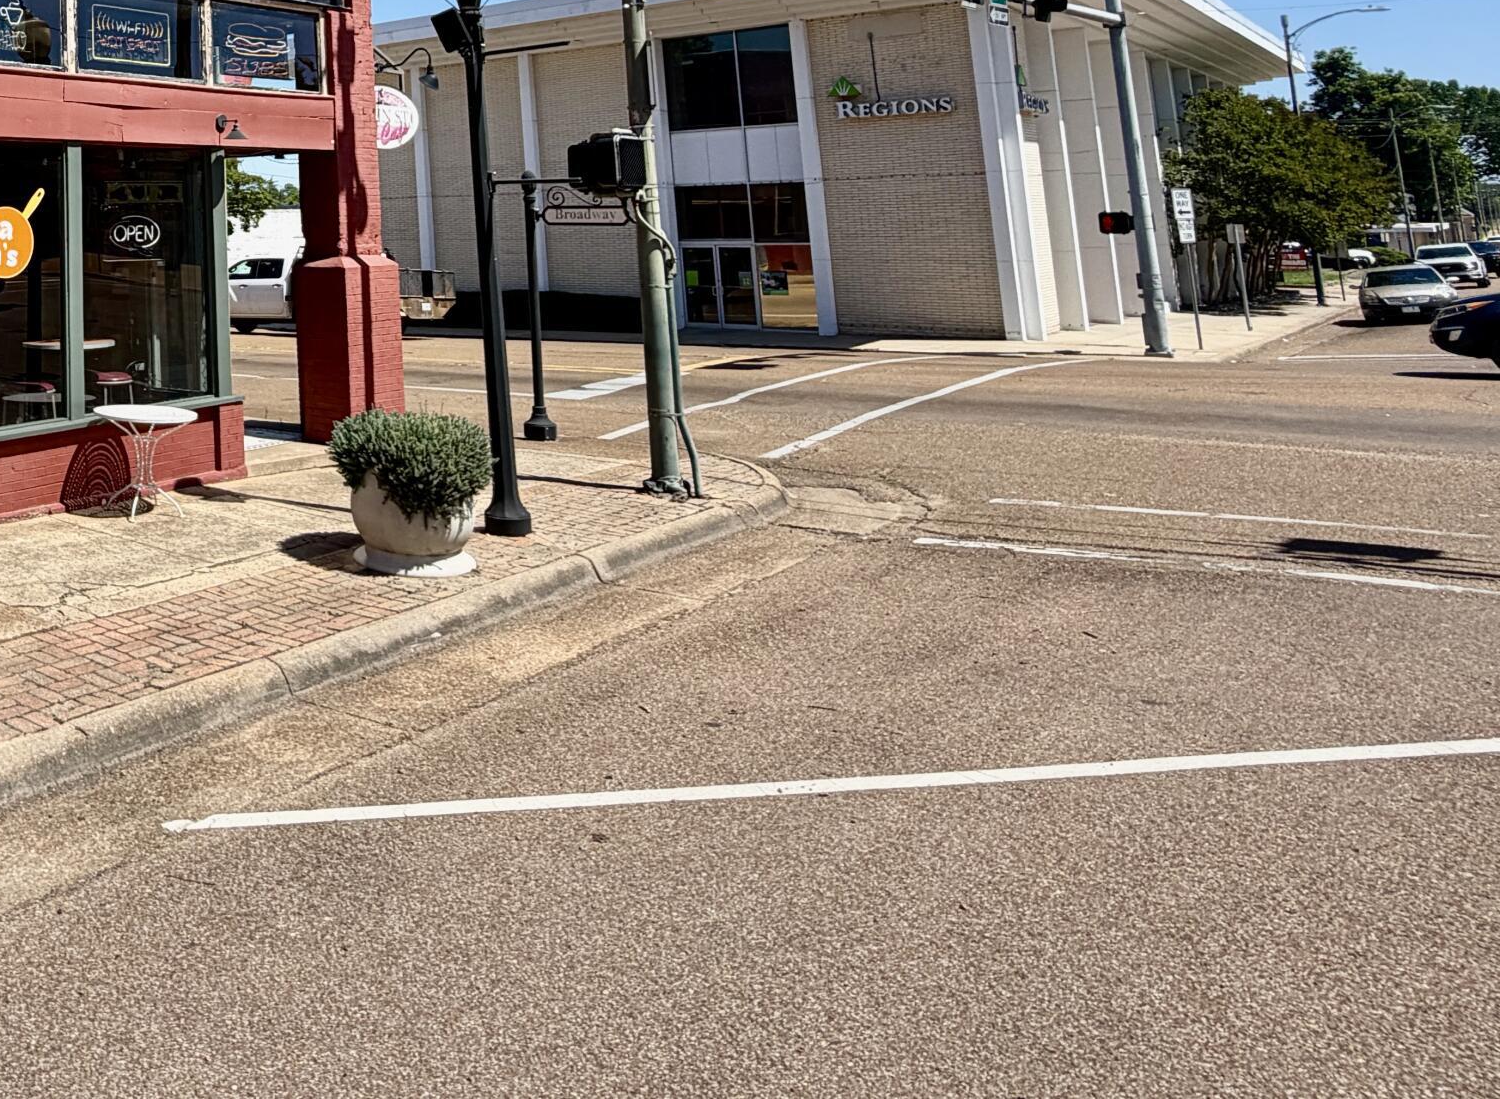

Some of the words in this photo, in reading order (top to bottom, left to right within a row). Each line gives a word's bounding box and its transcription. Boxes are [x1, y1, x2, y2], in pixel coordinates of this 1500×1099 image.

[835, 97, 952, 119] REGIONS
[555, 208, 617, 221] Broadway
[113, 225, 154, 242] OPEN
